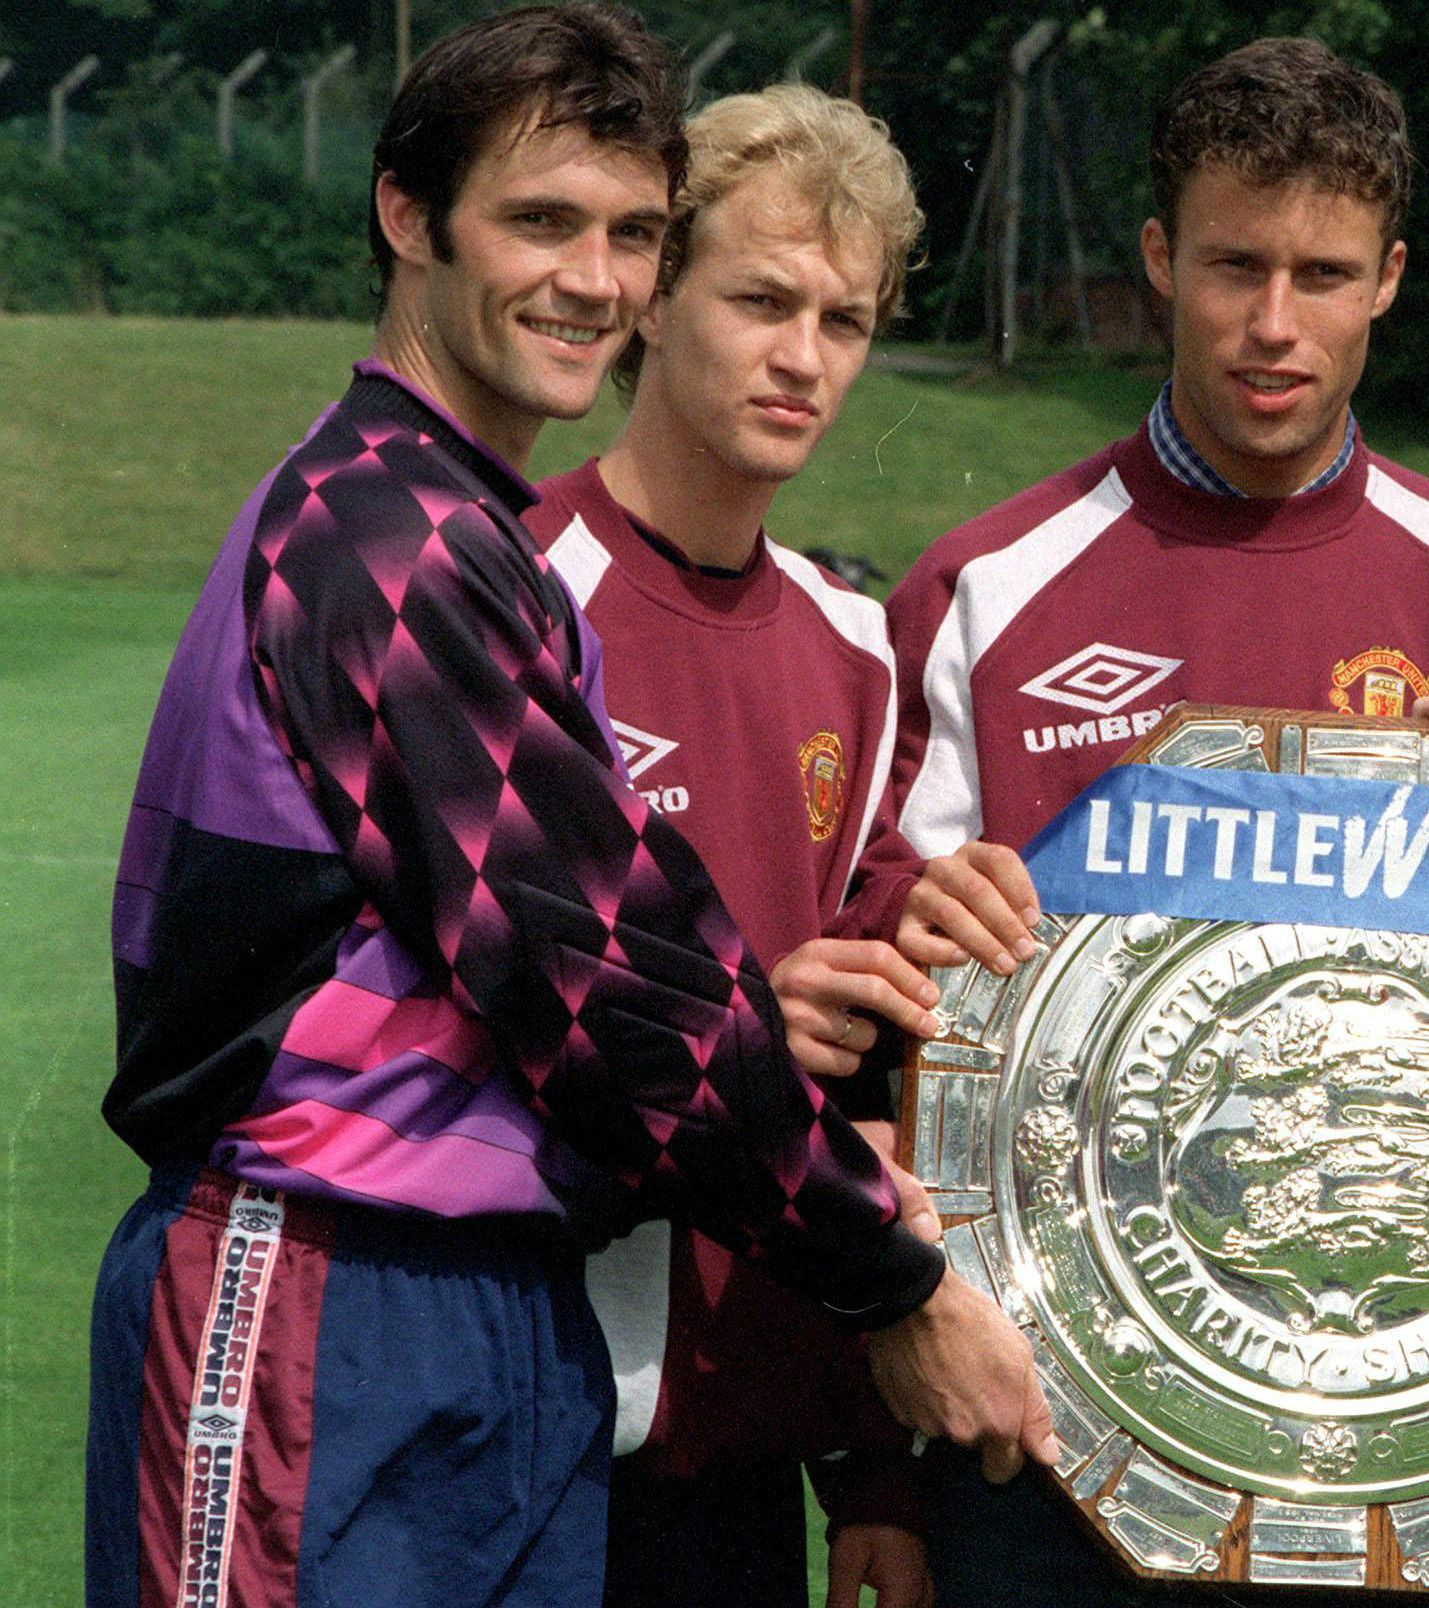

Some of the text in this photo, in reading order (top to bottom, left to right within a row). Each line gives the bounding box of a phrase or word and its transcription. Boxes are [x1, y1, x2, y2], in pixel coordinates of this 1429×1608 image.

[1023, 700, 1186, 753] UMBR
[1337, 653, 1402, 688] MANCHESTER
[1112, 922, 1320, 1127] FOOTBALL
[199, 1236, 248, 1406] UMBRO
[220, 1240, 271, 1407] UMBRO
[1118, 1205, 1329, 1386] CHARITY
